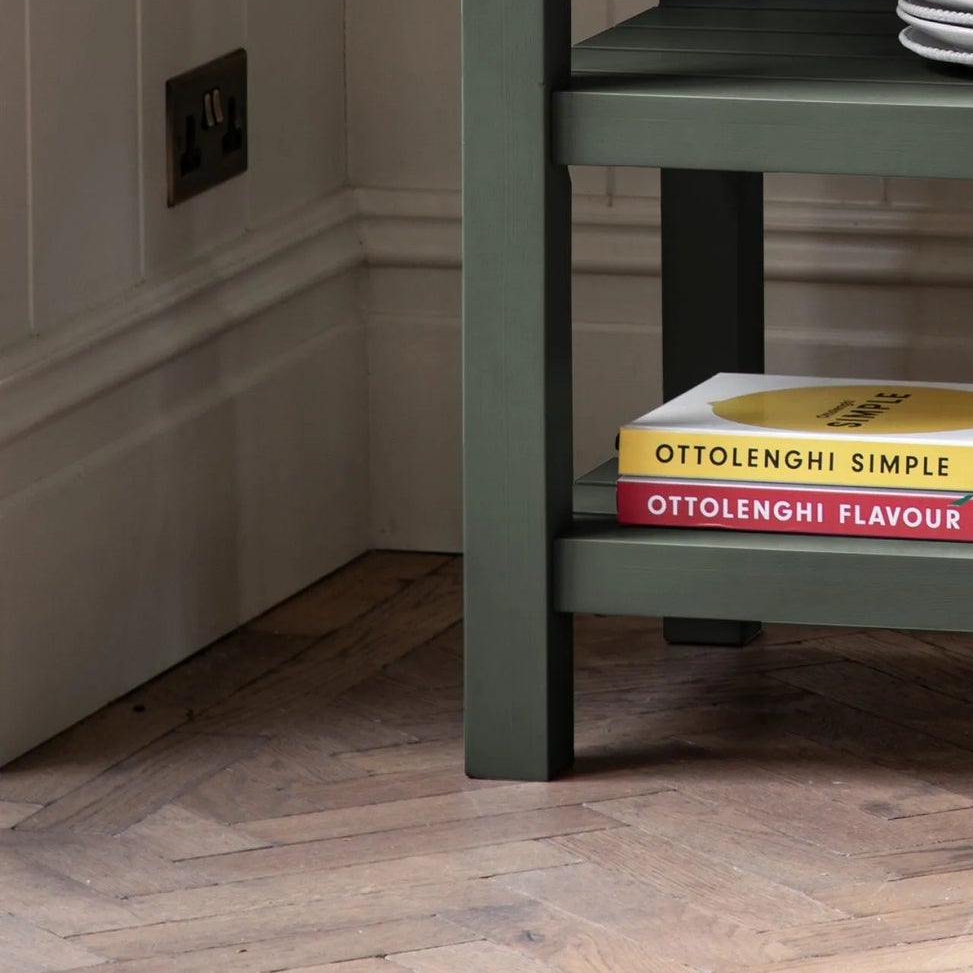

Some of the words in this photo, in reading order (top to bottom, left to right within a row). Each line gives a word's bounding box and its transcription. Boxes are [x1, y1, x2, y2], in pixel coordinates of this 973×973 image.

[826, 393, 912, 428] SIMPLE
[655, 444, 834, 471] OTTOLENGHI
[851, 453, 949, 476] SIMPLE
[647, 495, 823, 523] OTTOLENGHI
[839, 504, 961, 530] FLAVOUR
